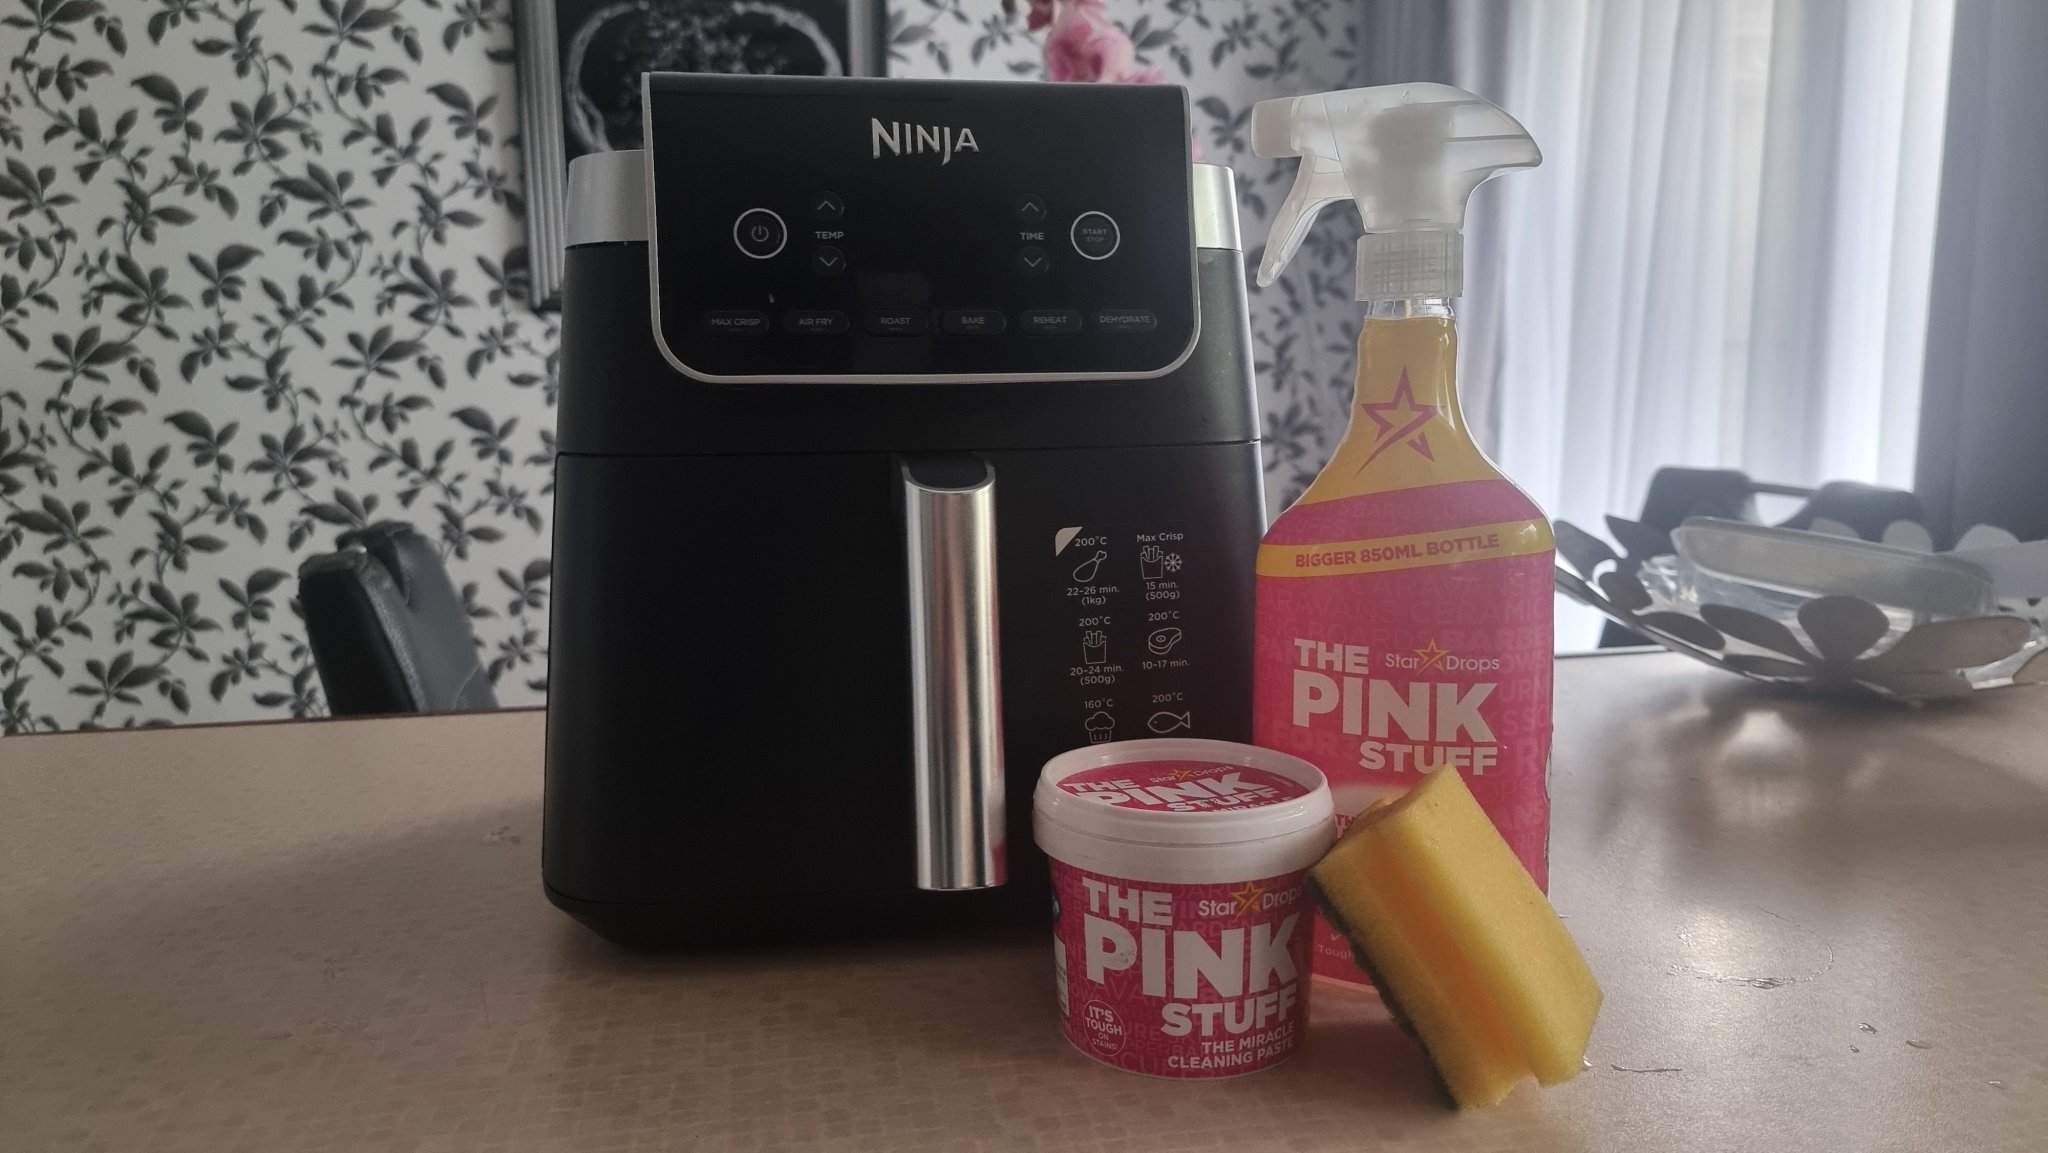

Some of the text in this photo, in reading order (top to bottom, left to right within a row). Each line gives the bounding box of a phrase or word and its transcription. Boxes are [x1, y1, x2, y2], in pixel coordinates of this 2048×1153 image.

[871, 117, 980, 166] NINJA
[815, 230, 845, 240] TEMP
[1019, 231, 1045, 241] TIME
[711, 318, 760, 326] MAX CRISP
[798, 318, 833, 326] AIR FRY
[880, 317, 912, 325] ROAST
[961, 316, 985, 325] BAKE
[1033, 316, 1068, 324] REHEAT
[1099, 316, 1151, 324] DEHYDRATE
[1075, 536, 1108, 547] 200°C
[1136, 532, 1184, 543] Max Crisp
[1295, 533, 1500, 567] BIGGER 850ML BOTTLE
[1067, 586, 1120, 596] 22-26 min.
[1146, 581, 1179, 590] 15 min.
[1081, 595, 1106, 606] (1kg)
[1145, 590, 1181, 601] (500g)
[1079, 616, 1111, 627] 200°C
[1148, 611, 1180, 621] 200°C
[1294, 637, 1370, 674] THE
[1142, 659, 1191, 670] 10-17 min.
[1385, 651, 1420, 670] Star
[1446, 654, 1500, 674] Drops
[1070, 664, 1124, 676] 20-24 min.
[1080, 675, 1116, 686] (500g)
[1152, 692, 1183, 703] 200°C
[1292, 668, 1498, 743] PINK
[1358, 740, 1498, 776] STUFF
[1150, 775, 1176, 784] Star
[1064, 778, 1141, 793] THE
[1076, 771, 1272, 806] PINK
[1166, 786, 1280, 812] STUFF
[1082, 876, 1173, 926] THE
[1199, 899, 1237, 917] Star
[1083, 912, 1301, 999] PINK
[1088, 1004, 1114, 1024] IT'S
[1159, 983, 1297, 1037] STUFF
[1084, 1016, 1124, 1036] TOUGH
[1098, 1031, 1110, 1041] ON
[1202, 1041, 1235, 1055] THE
[1239, 1020, 1295, 1051] MIRACLE
[1092, 1037, 1119, 1051] STAINS!
[1167, 1037, 1294, 1070] CLEANING PASTE
